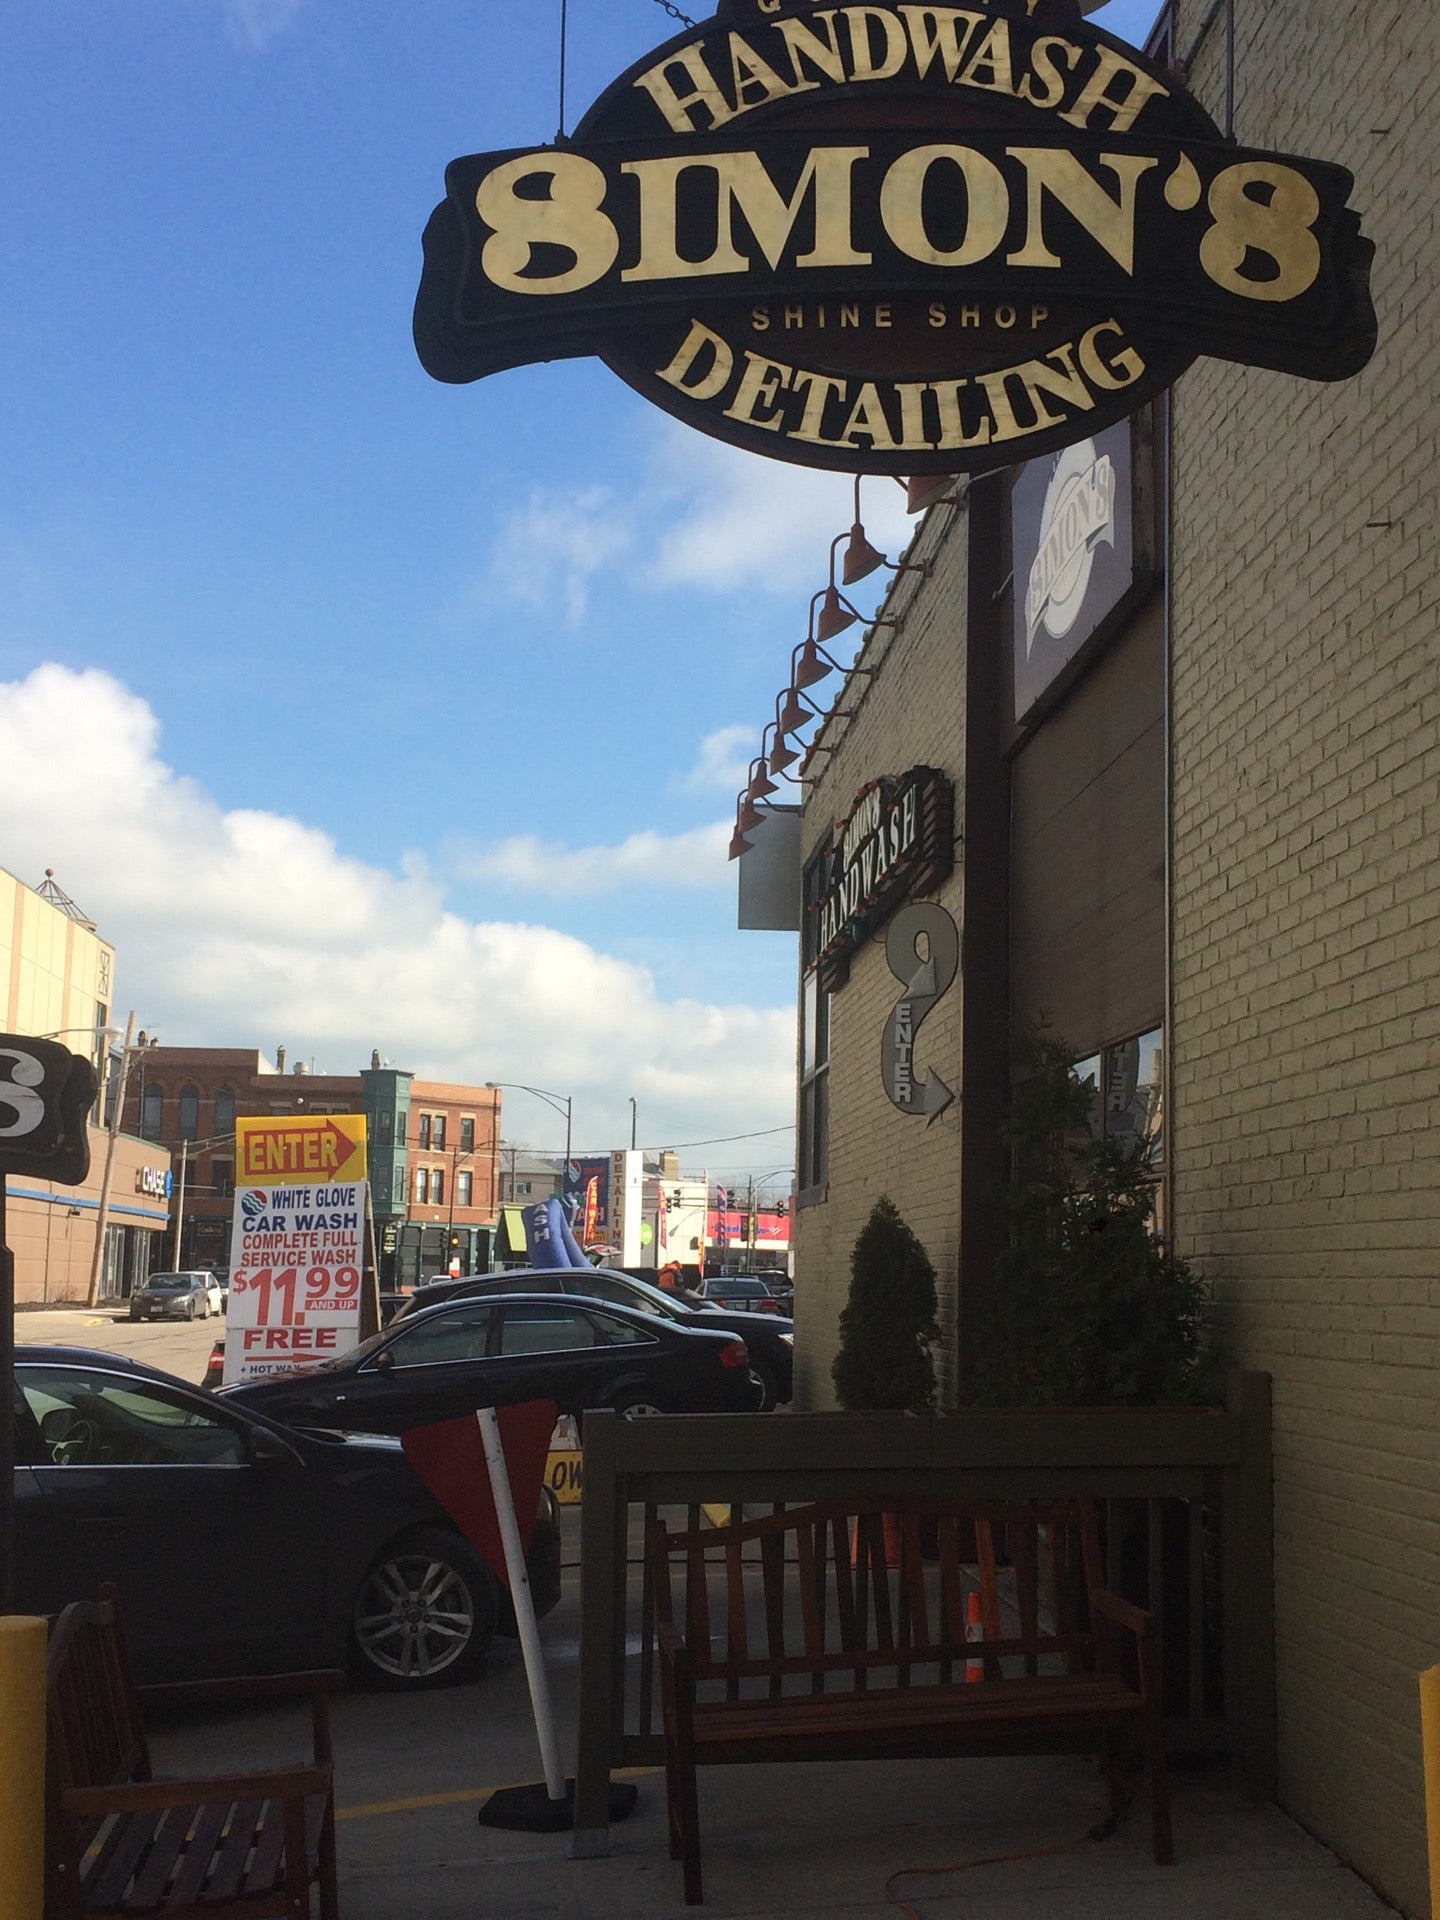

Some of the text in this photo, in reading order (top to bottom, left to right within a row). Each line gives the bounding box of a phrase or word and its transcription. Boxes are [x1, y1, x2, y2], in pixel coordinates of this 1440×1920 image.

[633, 4, 1172, 134] HANDWASH
[476, 143, 1323, 301] SIMON'S
[751, 302, 1051, 331] SHINE SHOP
[656, 316, 1147, 452] DETAILING
[820, 783, 917, 954] HANDWASH
[894, 1003, 912, 1103] ENTER
[249, 1131, 338, 1171] ENTER
[143, 1166, 165, 1195] CHASE
[272, 1188, 355, 1209] WHITE GLOVE
[612, 1153, 623, 1250] DETAILING
[242, 1215, 286, 1233] CAR
[295, 1212, 358, 1231] WASH
[242, 1230, 357, 1250] COMPLETE FULL
[241, 1249, 356, 1267] SERVICE WASH
[310, 1300, 354, 1310] AND UP
[243, 1328, 337, 1350] FREE
[250, 1365, 273, 1374] HOT
